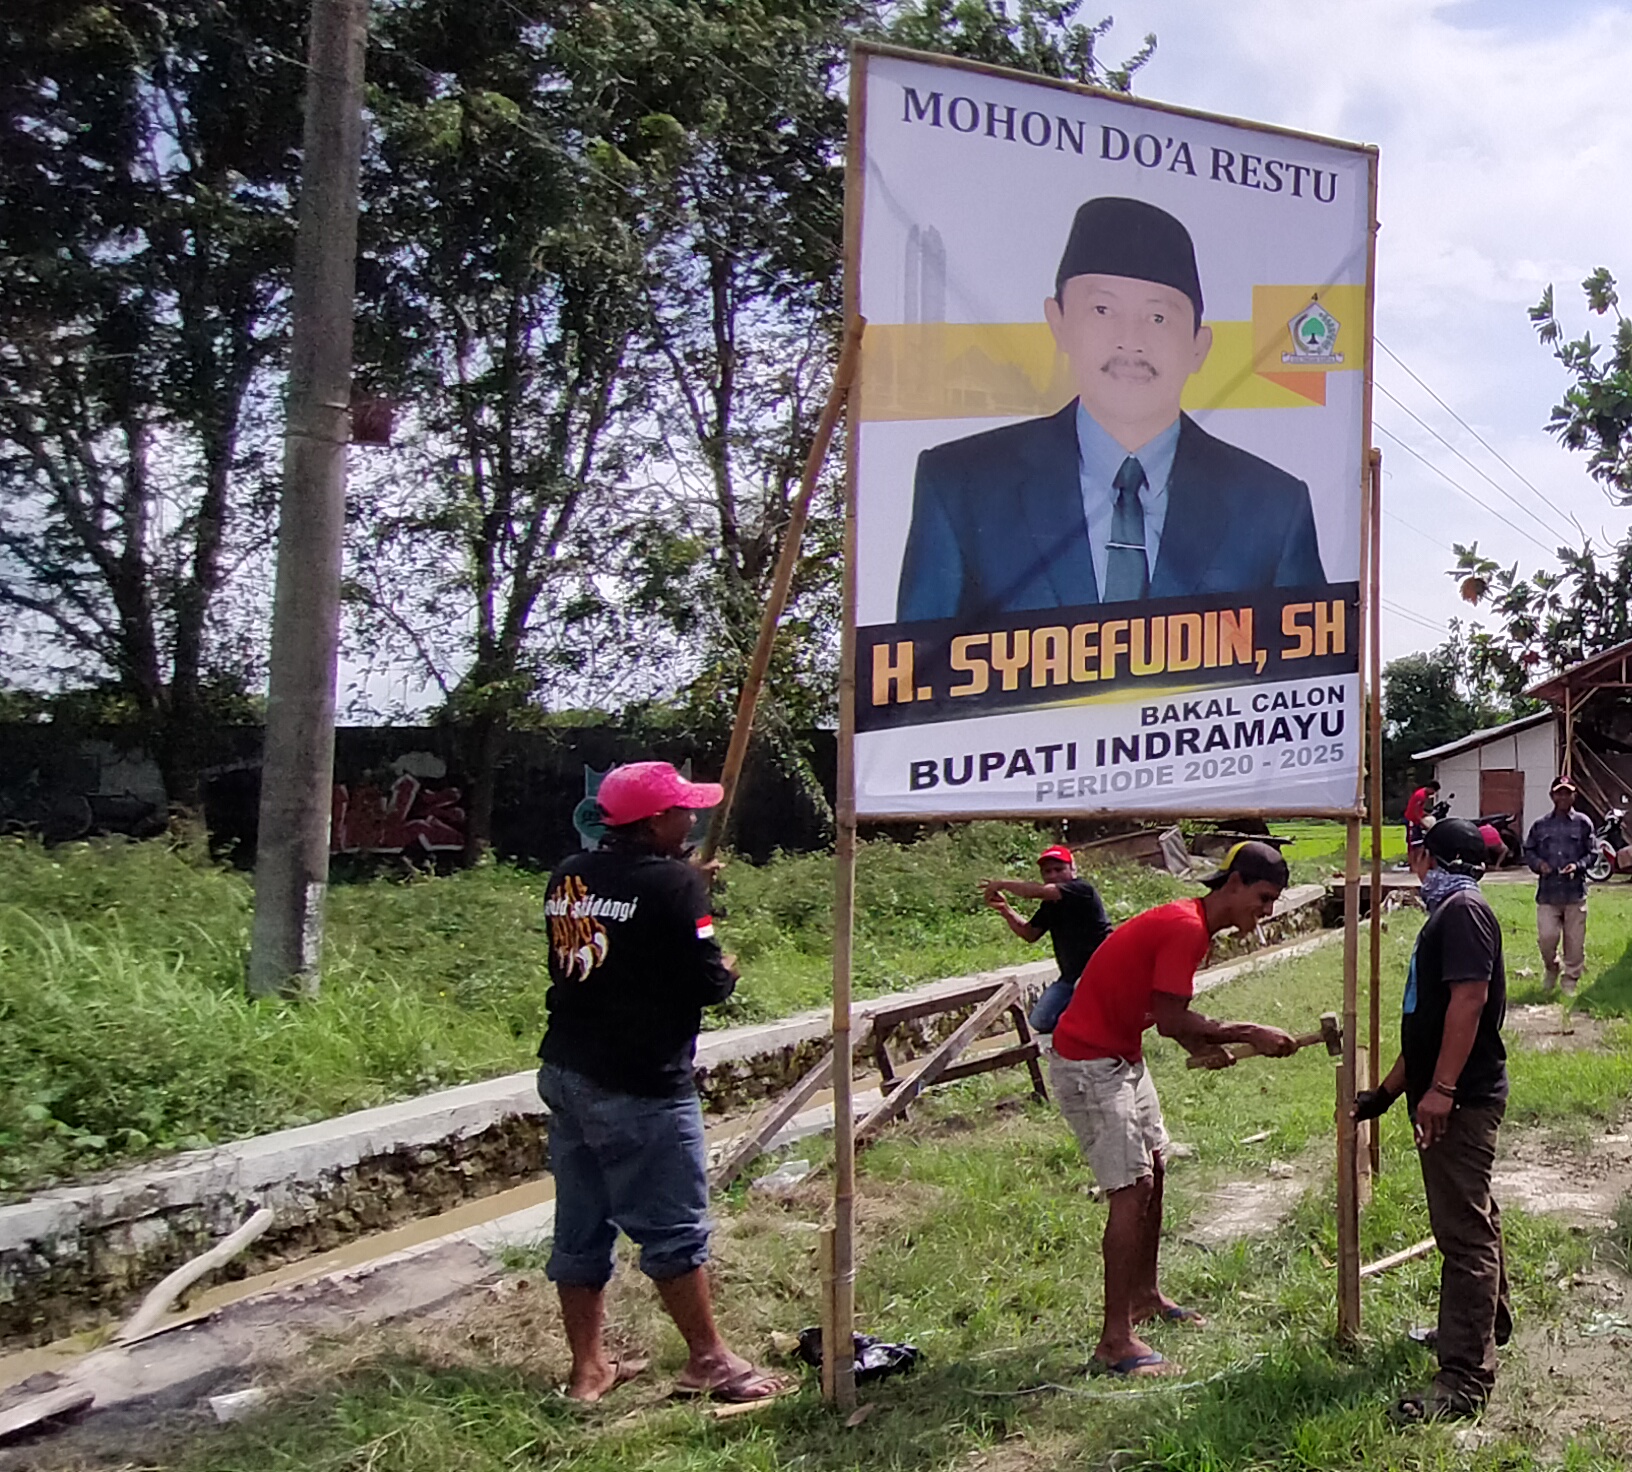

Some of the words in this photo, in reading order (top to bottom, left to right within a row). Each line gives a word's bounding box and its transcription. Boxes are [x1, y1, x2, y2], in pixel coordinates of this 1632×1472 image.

[902, 86, 1086, 155] MOHON
[1099, 124, 1198, 177] DO'A
[1209, 147, 1339, 203] RESTU
[872, 641, 933, 706] H.
[949, 607, 1267, 698] SYAEFUDIN,
[1281, 599, 1346, 660] SH
[1141, 697, 1241, 727] BAKAL
[1252, 685, 1345, 713] CALON
[909, 742, 1077, 792] BUPATI
[1096, 709, 1345, 768] INDRAMAYU
[1036, 764, 1174, 802] PERIODE
[1184, 754, 1254, 782] 2020
[1280, 743, 1344, 770] 2025
